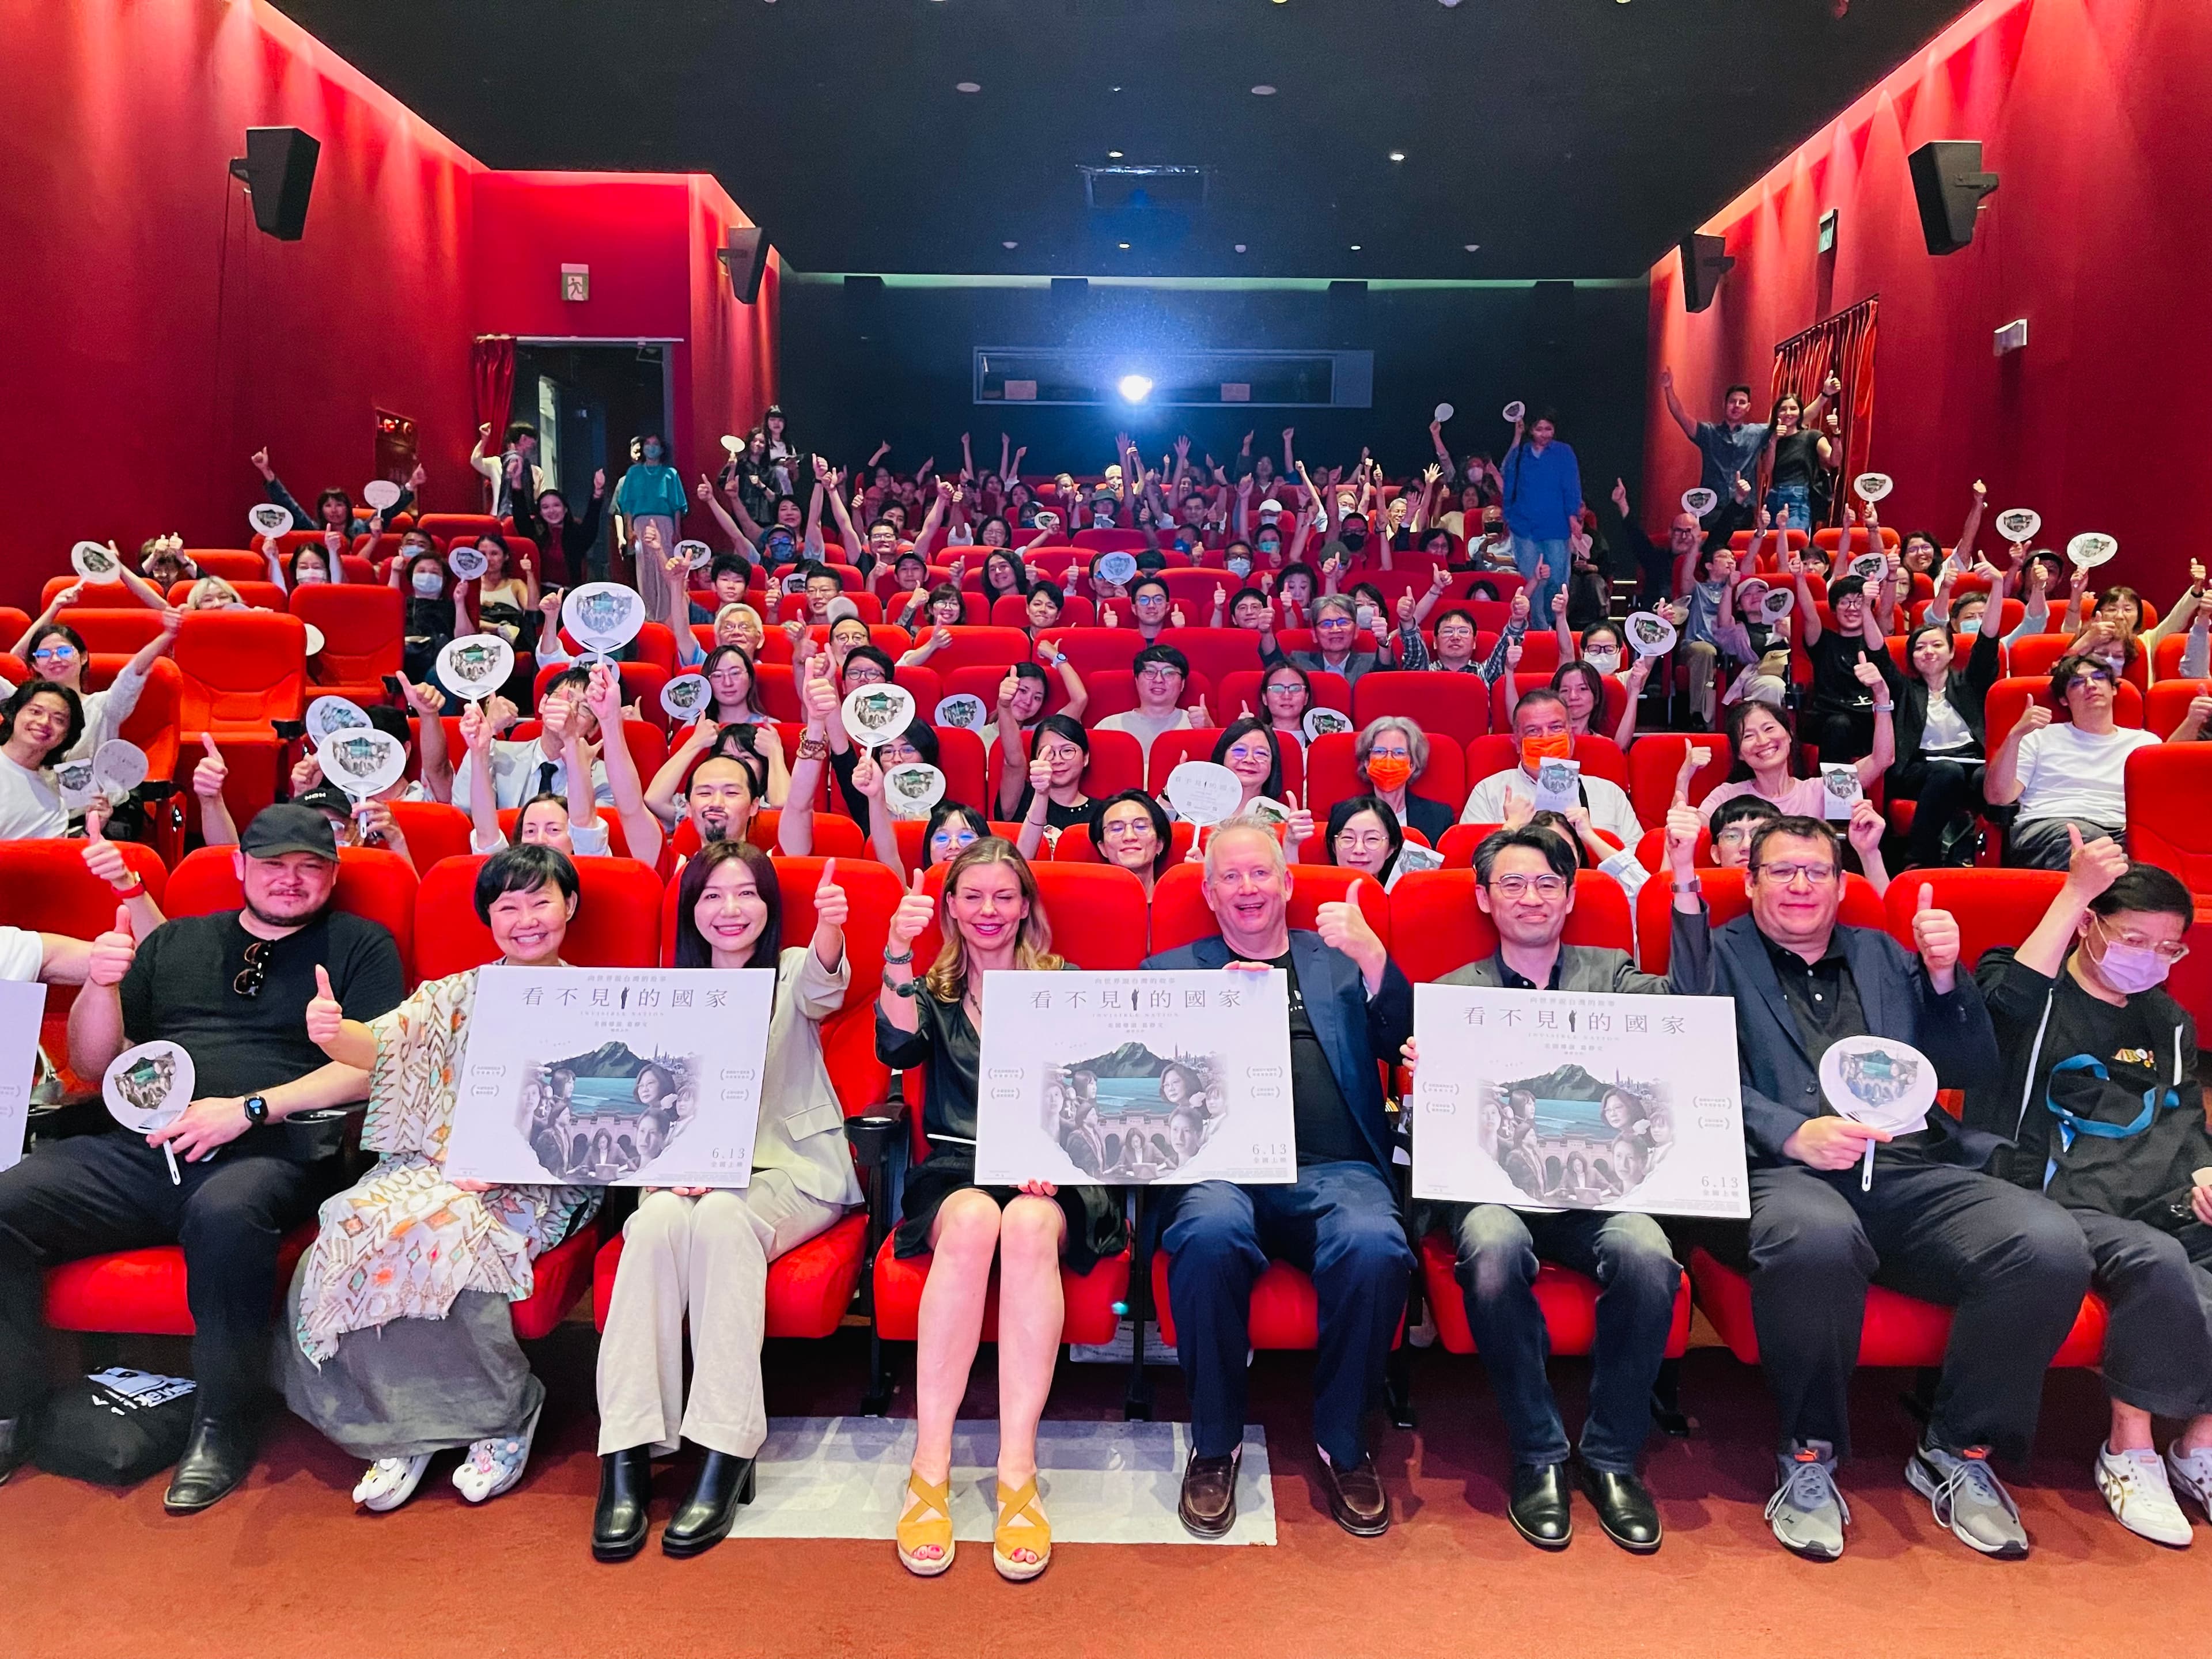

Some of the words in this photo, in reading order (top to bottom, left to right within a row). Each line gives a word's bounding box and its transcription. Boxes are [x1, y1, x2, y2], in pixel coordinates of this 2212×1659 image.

[522, 986, 728, 1009] 看不見的國家
[1030, 990, 1241, 1010] 看不見的國家
[1464, 1006, 1685, 1035] 看不見的國家
[712, 1147, 745, 1160] 6.13
[1252, 1143, 1287, 1156] 6.13
[1701, 1176, 1739, 1189] 6.13
